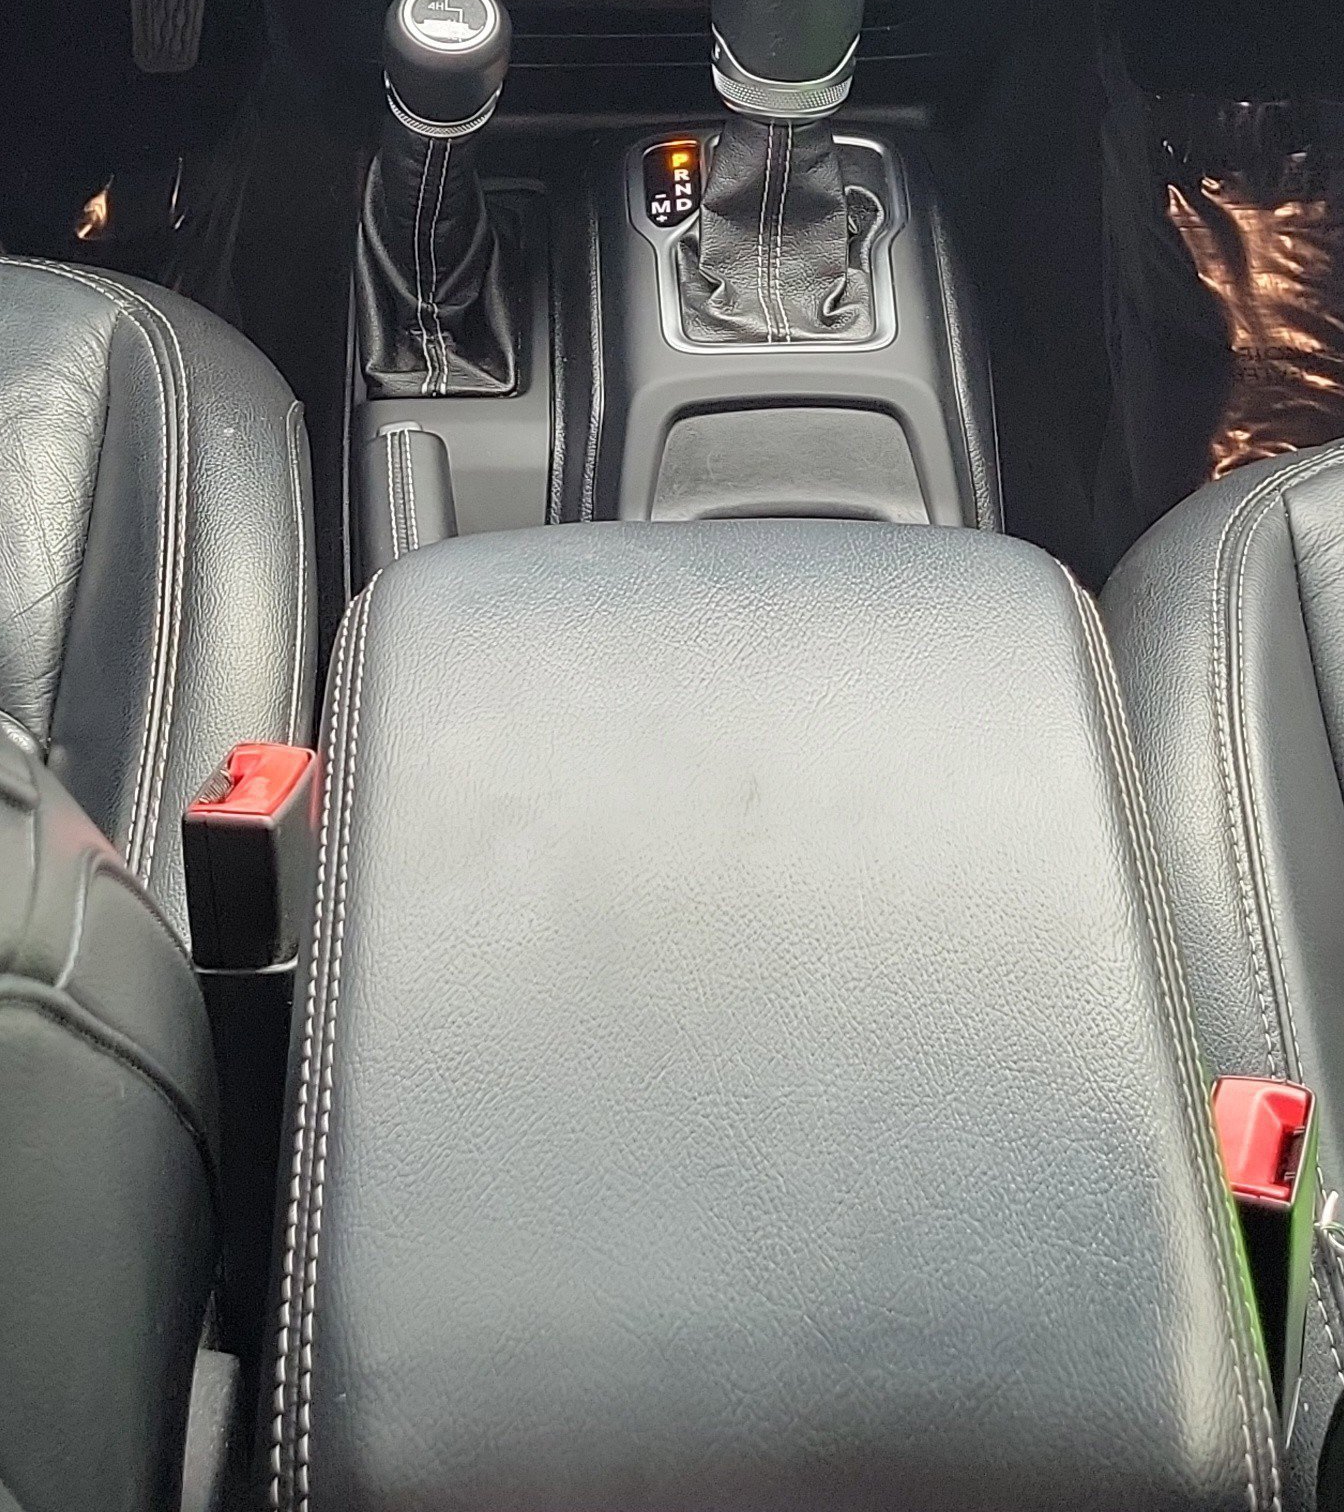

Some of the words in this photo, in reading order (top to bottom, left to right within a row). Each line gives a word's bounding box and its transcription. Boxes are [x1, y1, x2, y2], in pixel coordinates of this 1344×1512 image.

[428, 1, 444, 11] 4H
[672, 153, 689, 168] P
[674, 169, 690, 182] R
[675, 183, 692, 197] N
[651, 199, 671, 215] M
[676, 198, 693, 211] D
